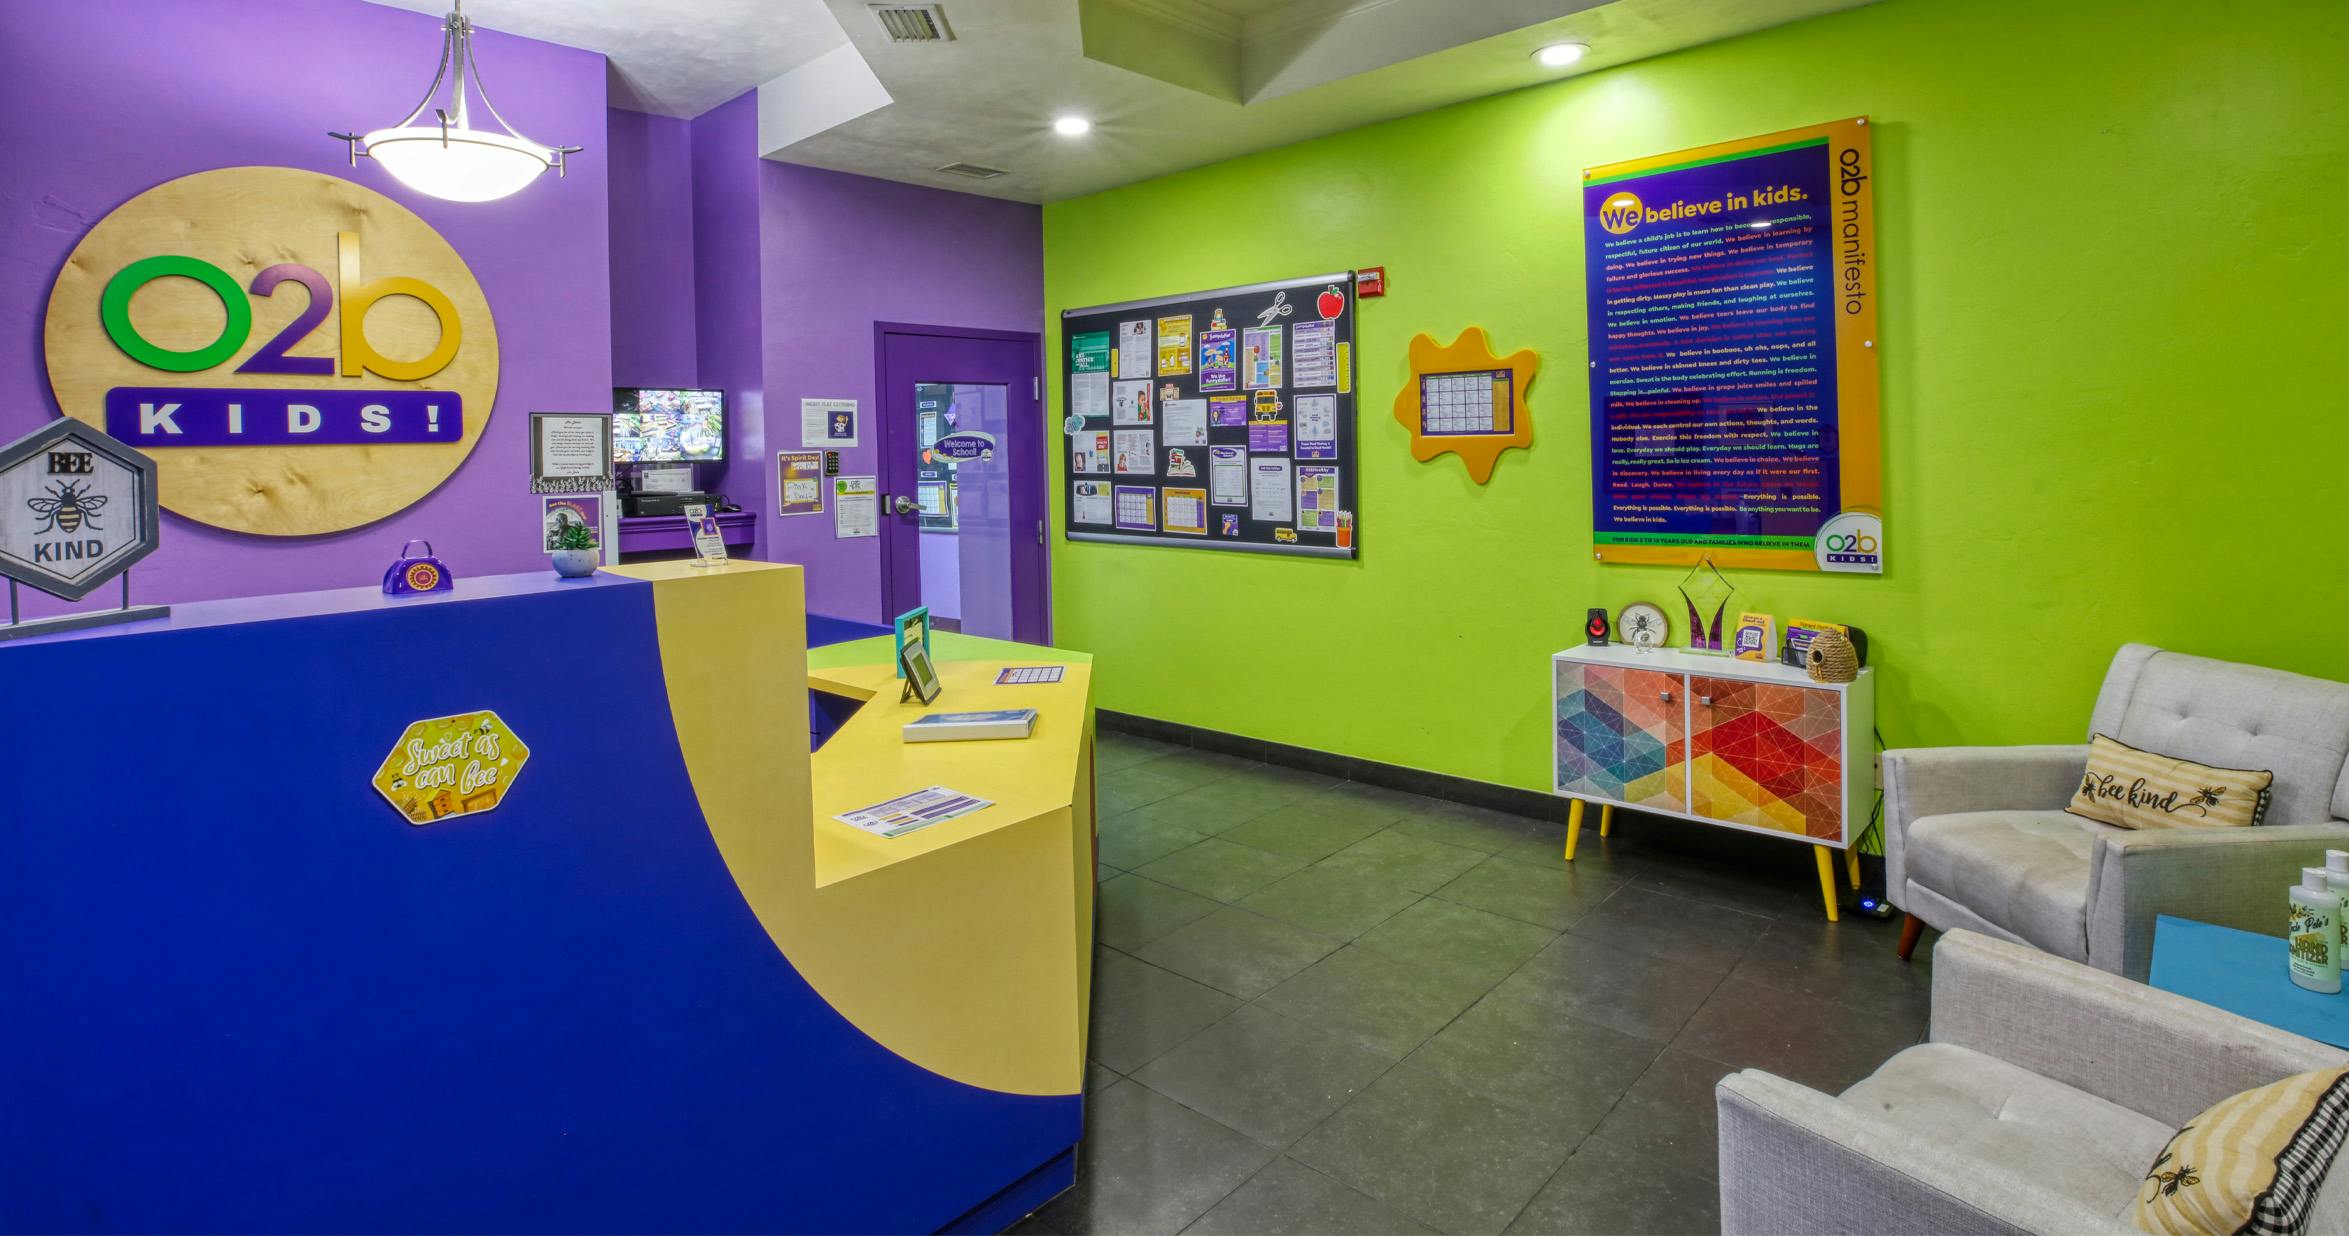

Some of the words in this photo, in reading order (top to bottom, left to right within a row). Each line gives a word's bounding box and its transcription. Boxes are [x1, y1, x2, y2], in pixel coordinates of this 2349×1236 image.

[1840, 148, 1868, 196] o2b
[1602, 207, 1640, 230] We
[1645, 198, 1722, 224] believe
[1726, 194, 1748, 212] in
[1753, 185, 1808, 207] kids.
[1605, 249, 1637, 260] respectful,
[1638, 246, 1657, 254] future
[1659, 243, 1680, 252] citizen
[1702, 237, 1723, 246] world.
[1737, 232, 1762, 241] believe
[1772, 226, 1801, 238] learning
[1615, 237, 1637, 246] believe
[1691, 227, 1708, 235] learn
[1636, 258, 1658, 266] believe
[1668, 254, 1687, 264] trying
[1703, 249, 1726, 259] things.
[1740, 244, 1764, 253] believe
[1775, 238, 1813, 250] temporary
[1842, 200, 1866, 315] manifesto
[101, 231, 462, 381] o2b
[1614, 306, 1646, 316] respecting
[1647, 304, 1670, 312] others,
[1671, 301, 1694, 311] making
[1696, 298, 1722, 307] friends,
[1738, 293, 1767, 304] laughing
[1672, 374, 1688, 382] body
[1688, 371, 1725, 381] celebrating
[1748, 368, 1776, 377] Running
[1784, 365, 1817, 373] freedom.
[1732, 357, 1750, 366] dirty
[1609, 389, 1636, 397] Stopping
[1736, 382, 1753, 390] juice
[1793, 378, 1818, 387] spilled
[138, 402, 440, 435] KIDS!
[944, 440, 976, 448] Welcome
[952, 448, 977, 456] School!
[47, 452, 94, 474] BEE
[34, 539, 104, 563] KIND
[1826, 528, 1878, 554] o2b
[403, 732, 473, 776] Sweet
[474, 732, 500, 760] as
[415, 764, 456, 789] can
[460, 760, 498, 794] bee
[2098, 774, 2126, 800] bee
[2127, 778, 2184, 814] kind
[2305, 916, 2328, 932] Pete's
